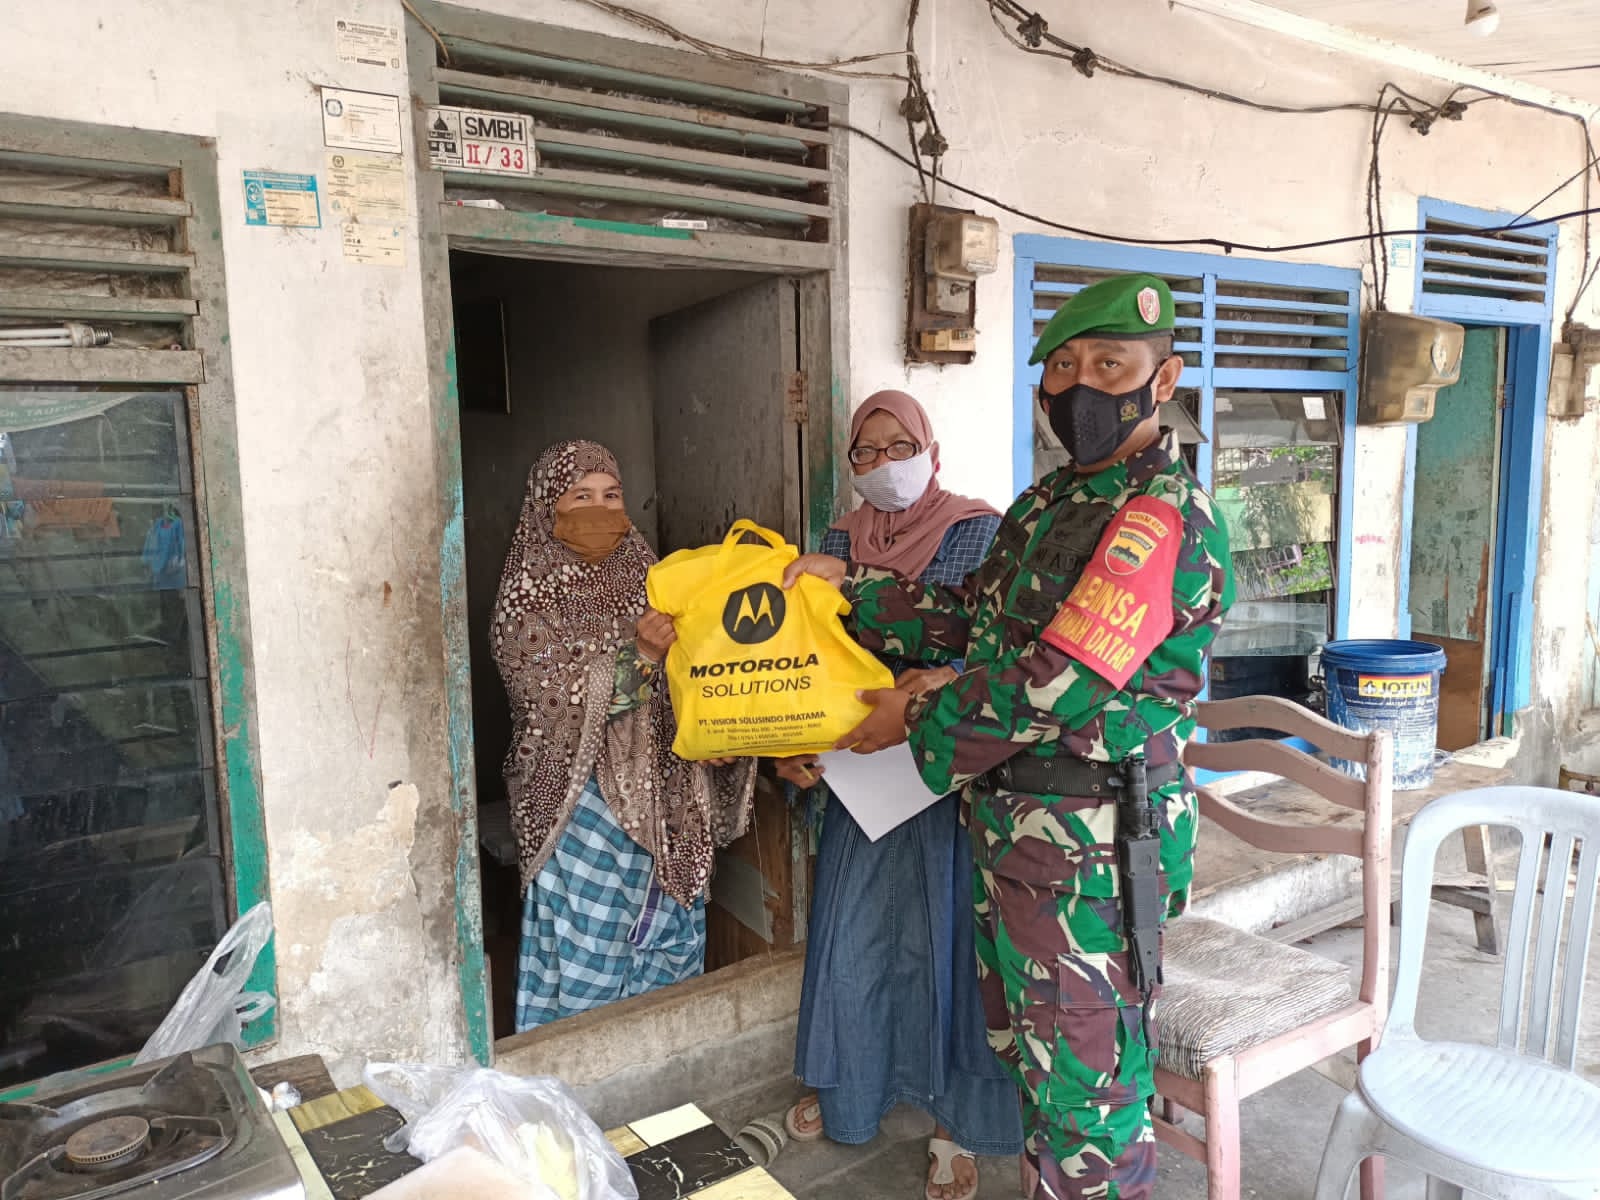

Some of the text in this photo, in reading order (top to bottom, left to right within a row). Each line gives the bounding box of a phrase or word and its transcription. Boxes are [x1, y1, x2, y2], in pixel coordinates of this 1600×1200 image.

[464, 116, 523, 141] SMBH
[1083, 625, 1136, 673] DATAR
[690, 653, 819, 678] MOTOROLA
[702, 675, 812, 698] SOLUTIONS
[1379, 680, 1429, 696] JOTUN
[711, 717, 737, 726] VISION
[785, 711, 826, 722] PRATAMA
